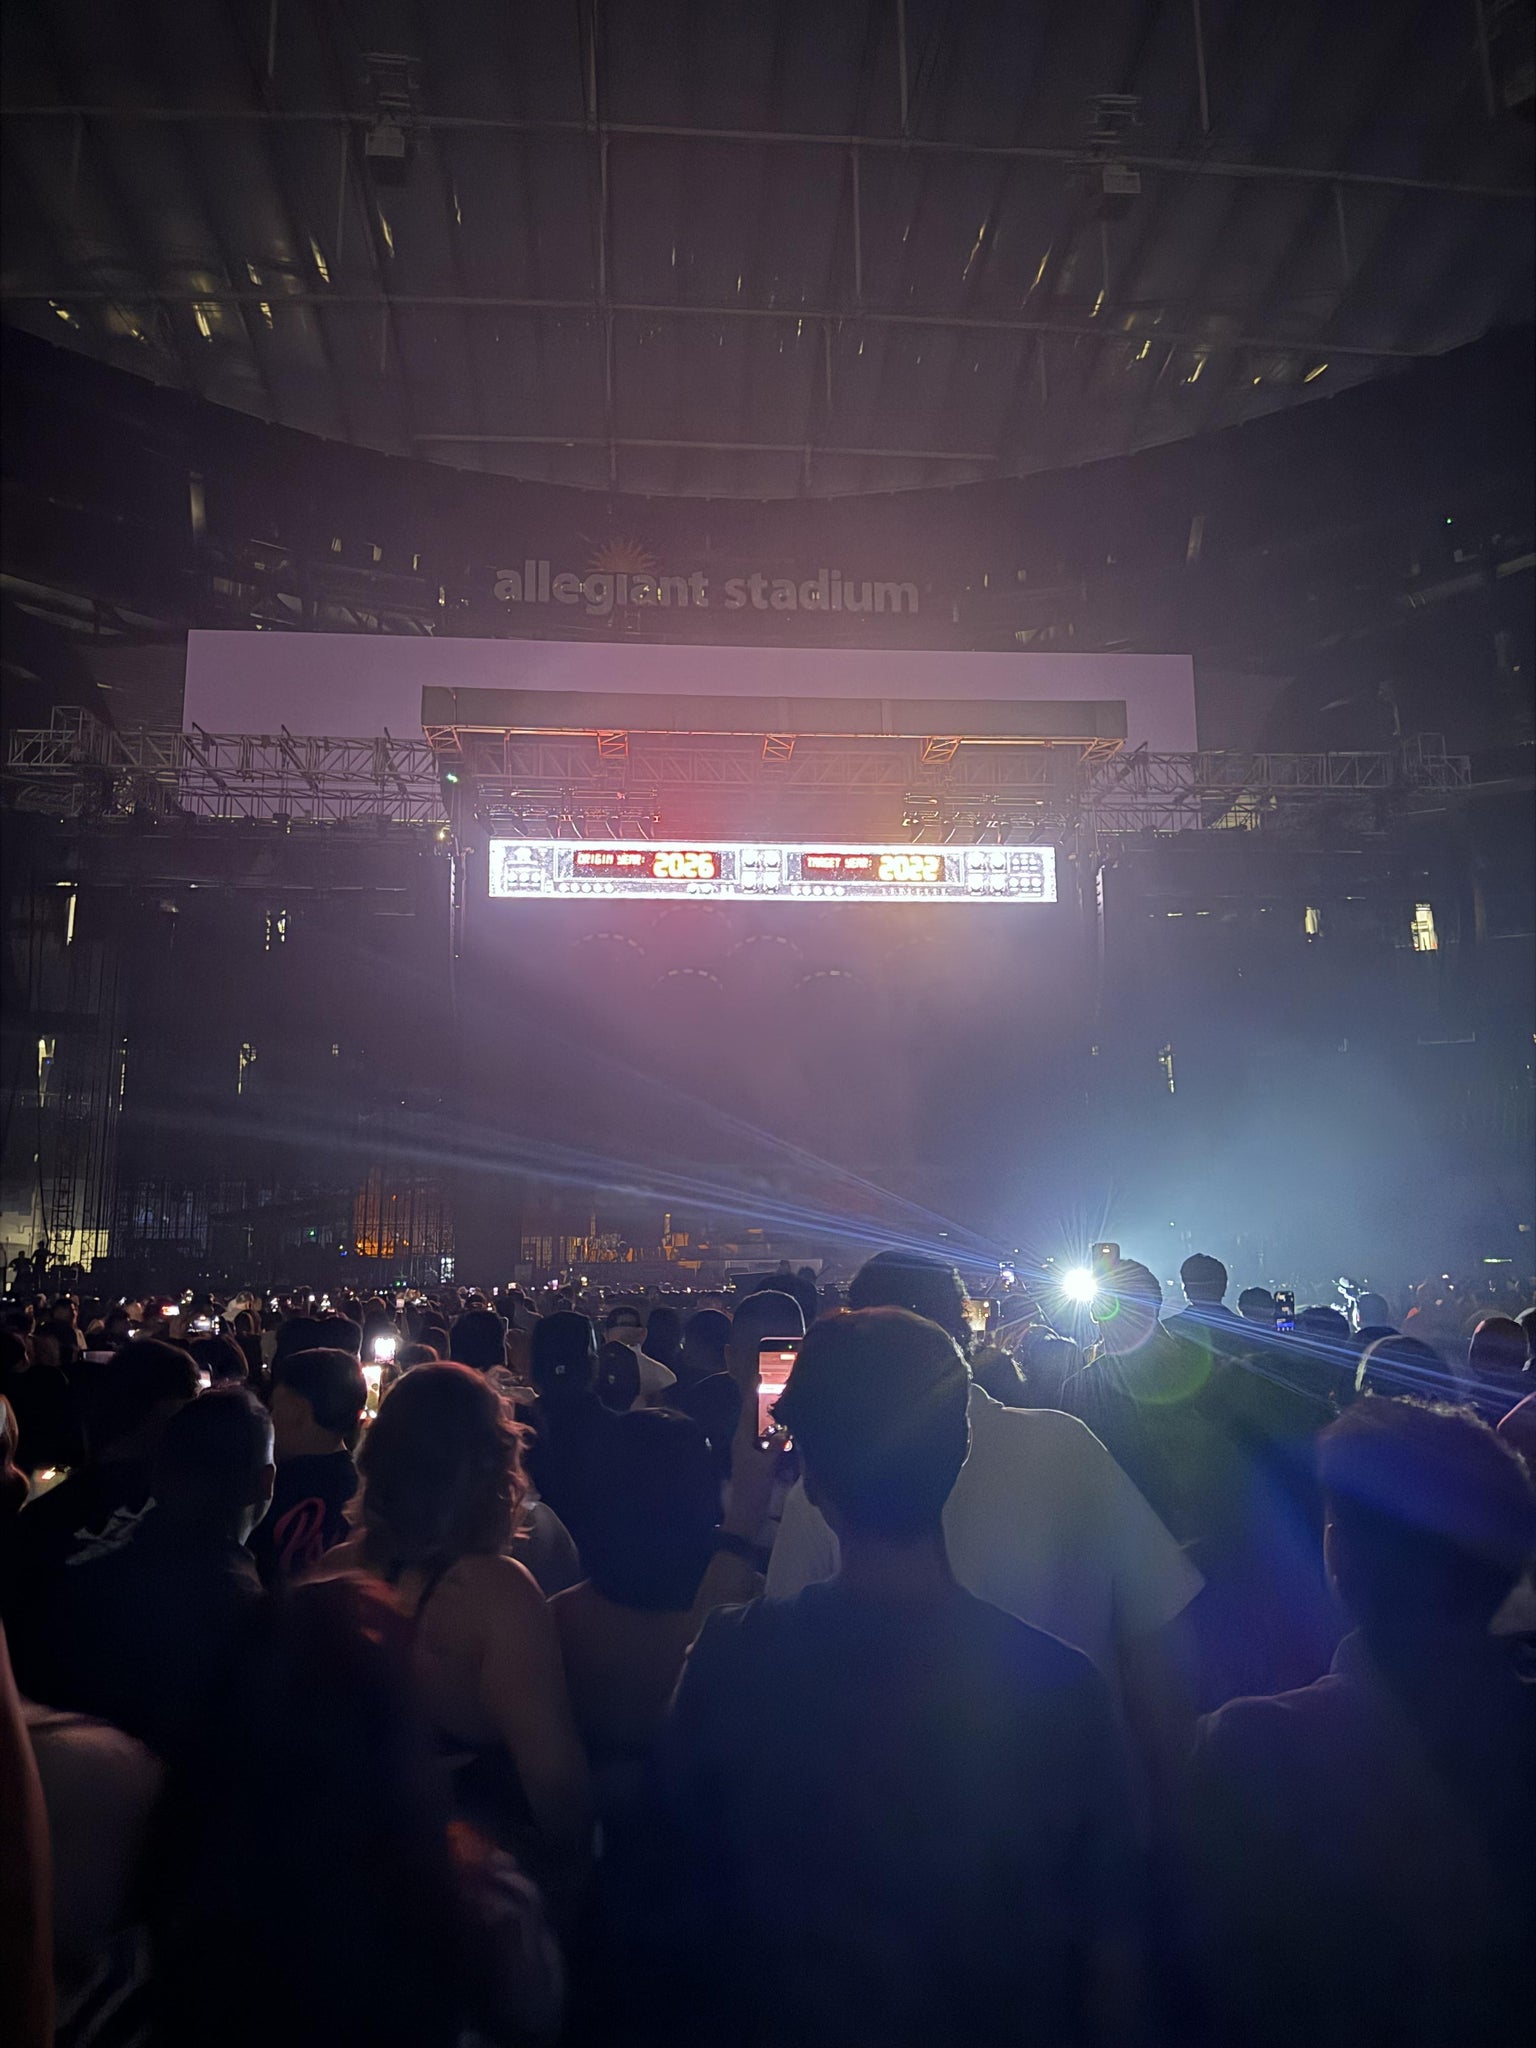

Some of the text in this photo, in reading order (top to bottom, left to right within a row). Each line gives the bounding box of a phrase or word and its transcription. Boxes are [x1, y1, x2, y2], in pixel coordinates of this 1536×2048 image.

[494, 560, 919, 614] allegiant stadium
[576, 852, 614, 865] ORIGIN
[653, 852, 715, 878] 2026
[878, 855, 939, 881] 2022
